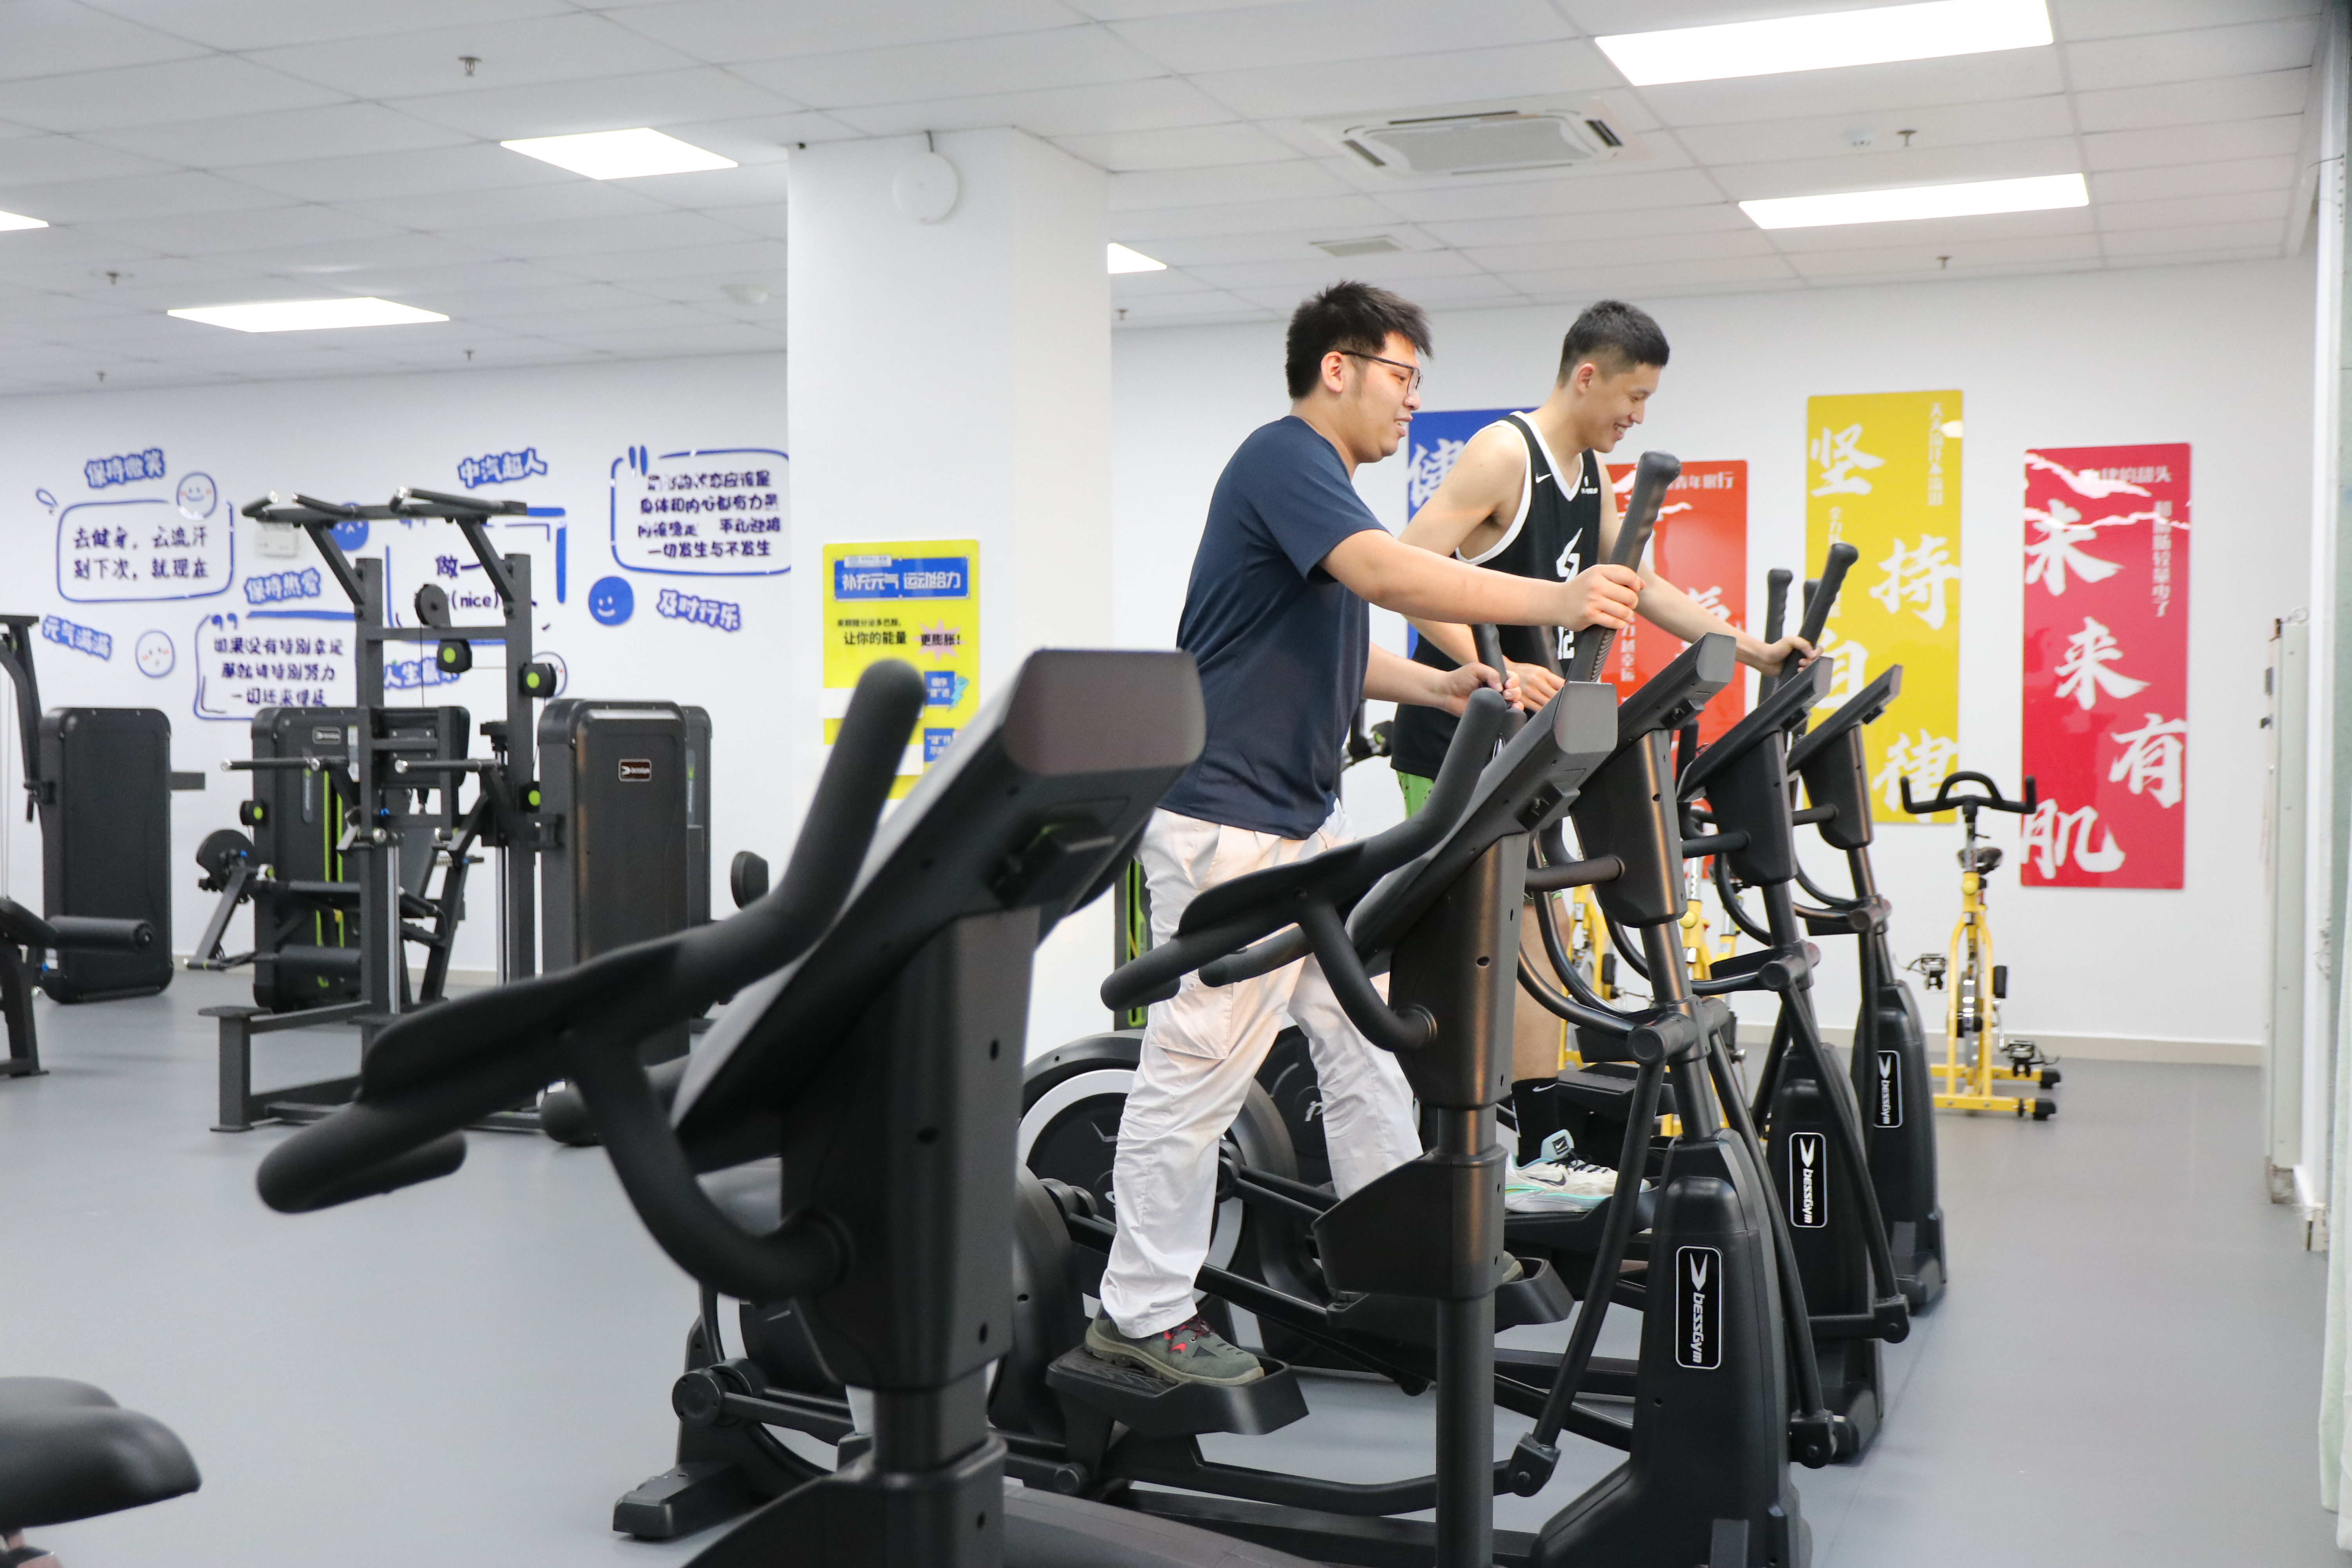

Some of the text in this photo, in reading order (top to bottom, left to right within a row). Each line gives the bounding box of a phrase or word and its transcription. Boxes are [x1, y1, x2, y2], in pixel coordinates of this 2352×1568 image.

[844, 631, 907, 645] 让你的能量
